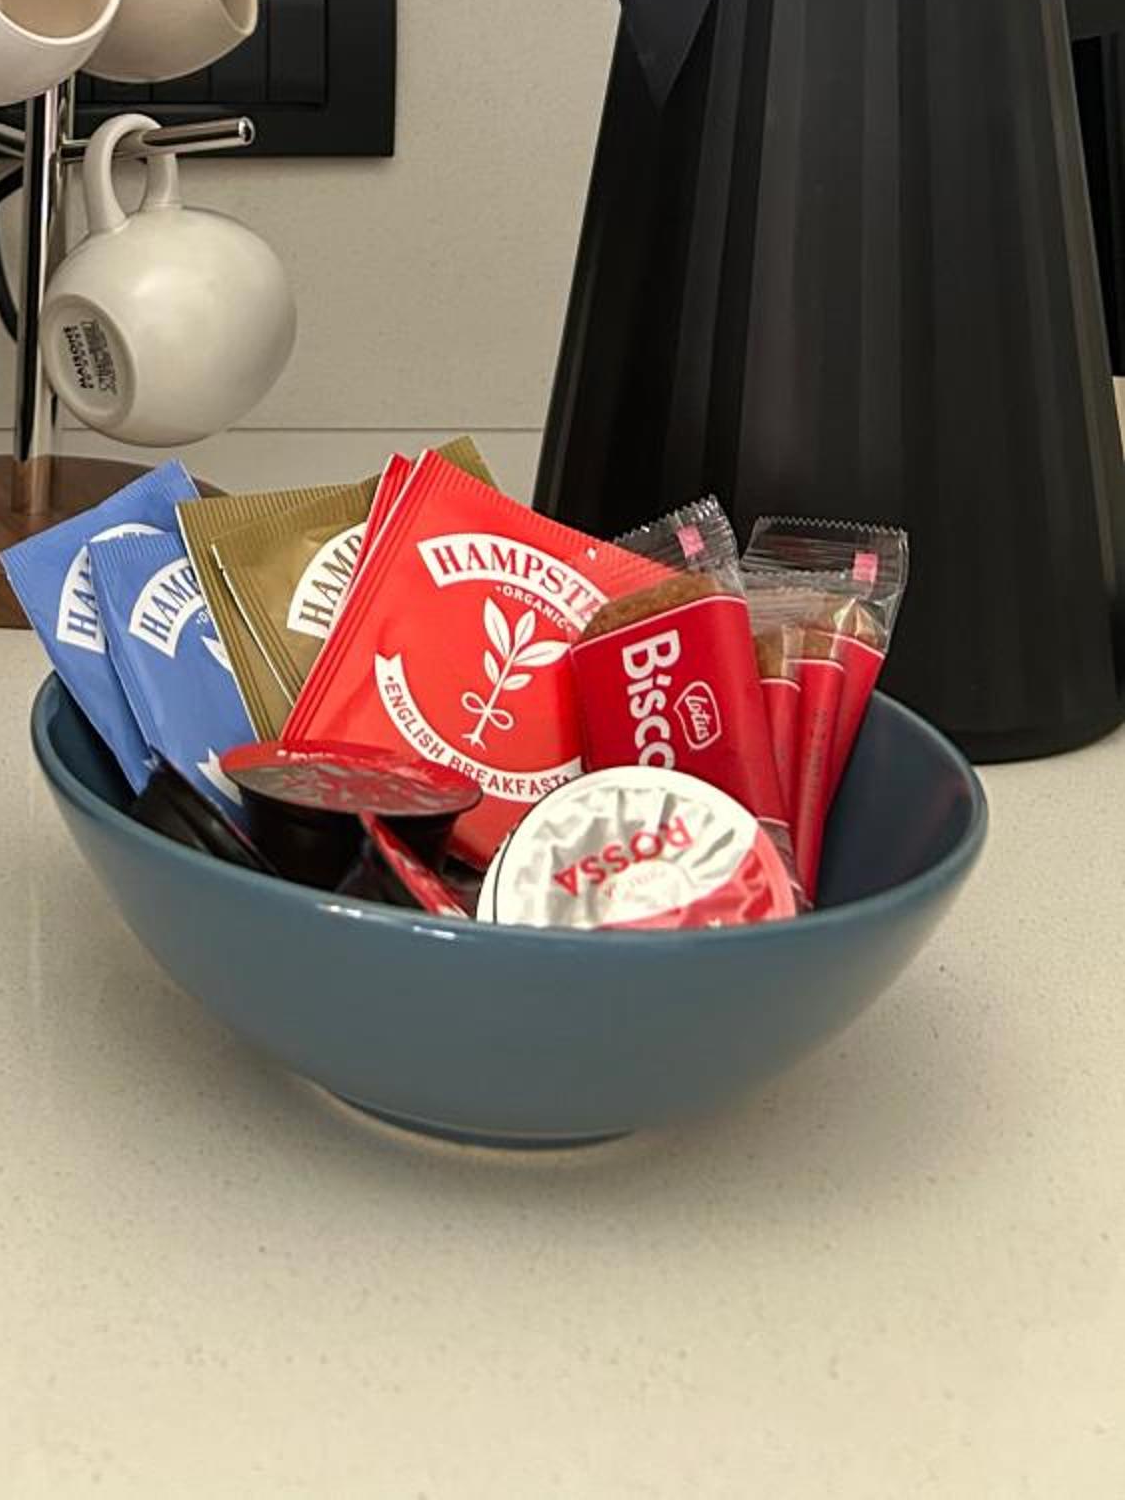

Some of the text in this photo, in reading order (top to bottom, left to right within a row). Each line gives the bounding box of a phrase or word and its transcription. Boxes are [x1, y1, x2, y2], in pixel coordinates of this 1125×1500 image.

[502, 585, 567, 628] ORGANIC
[384, 683, 565, 795] ENGLISH BREAKFAST
[621, 628, 681, 769] Bisco
[552, 816, 693, 897] ROSSA
